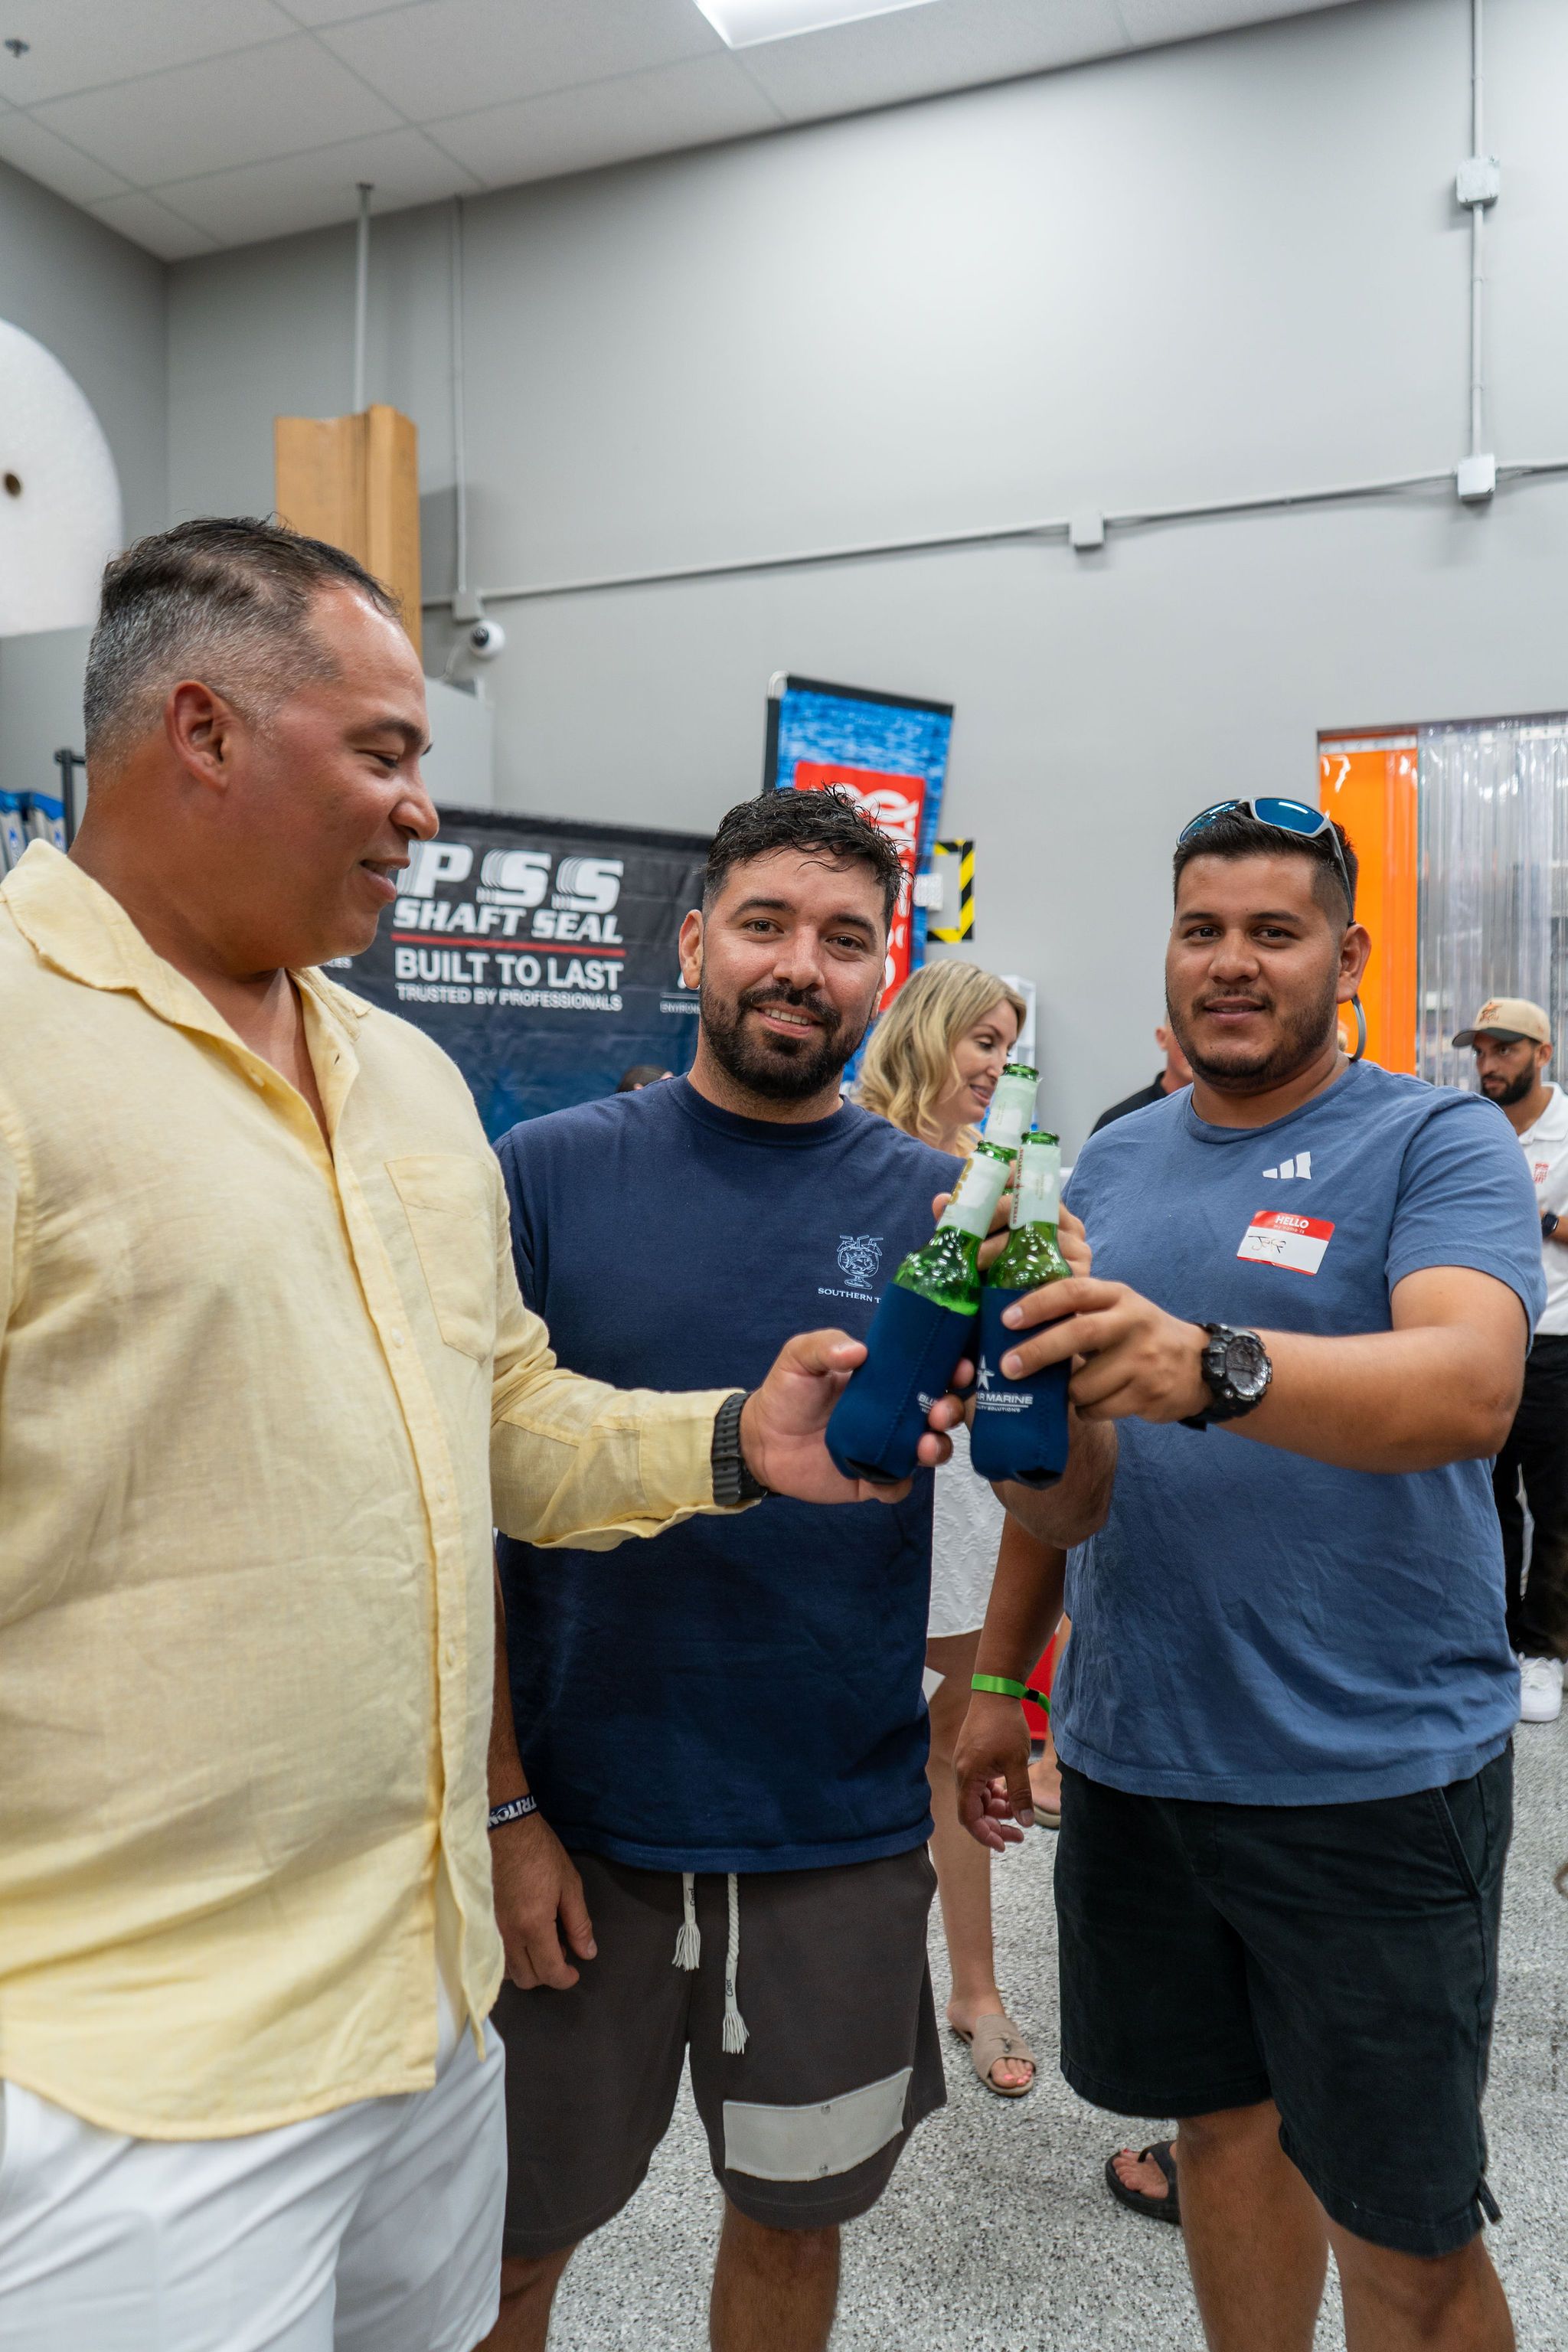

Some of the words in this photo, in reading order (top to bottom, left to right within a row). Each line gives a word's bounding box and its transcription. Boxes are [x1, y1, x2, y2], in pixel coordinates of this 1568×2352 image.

[397, 840, 624, 914] PSS
[393, 897, 526, 936] SHAFT
[531, 909, 623, 944] SEAL
[394, 947, 490, 984] BUILT
[495, 954, 541, 986] TO
[547, 957, 624, 991] LAST
[395, 983, 472, 1004] TRUSTED
[473, 987, 497, 1005] BY
[498, 988, 623, 1011] PROFESSIONALS
[660, 1001, 700, 1014] ENVIRON
[1275, 1215, 1309, 1229] HELLO
[818, 1288, 873, 1302] SOUTHERN
[985, 1393, 1033, 1405] MARINE
